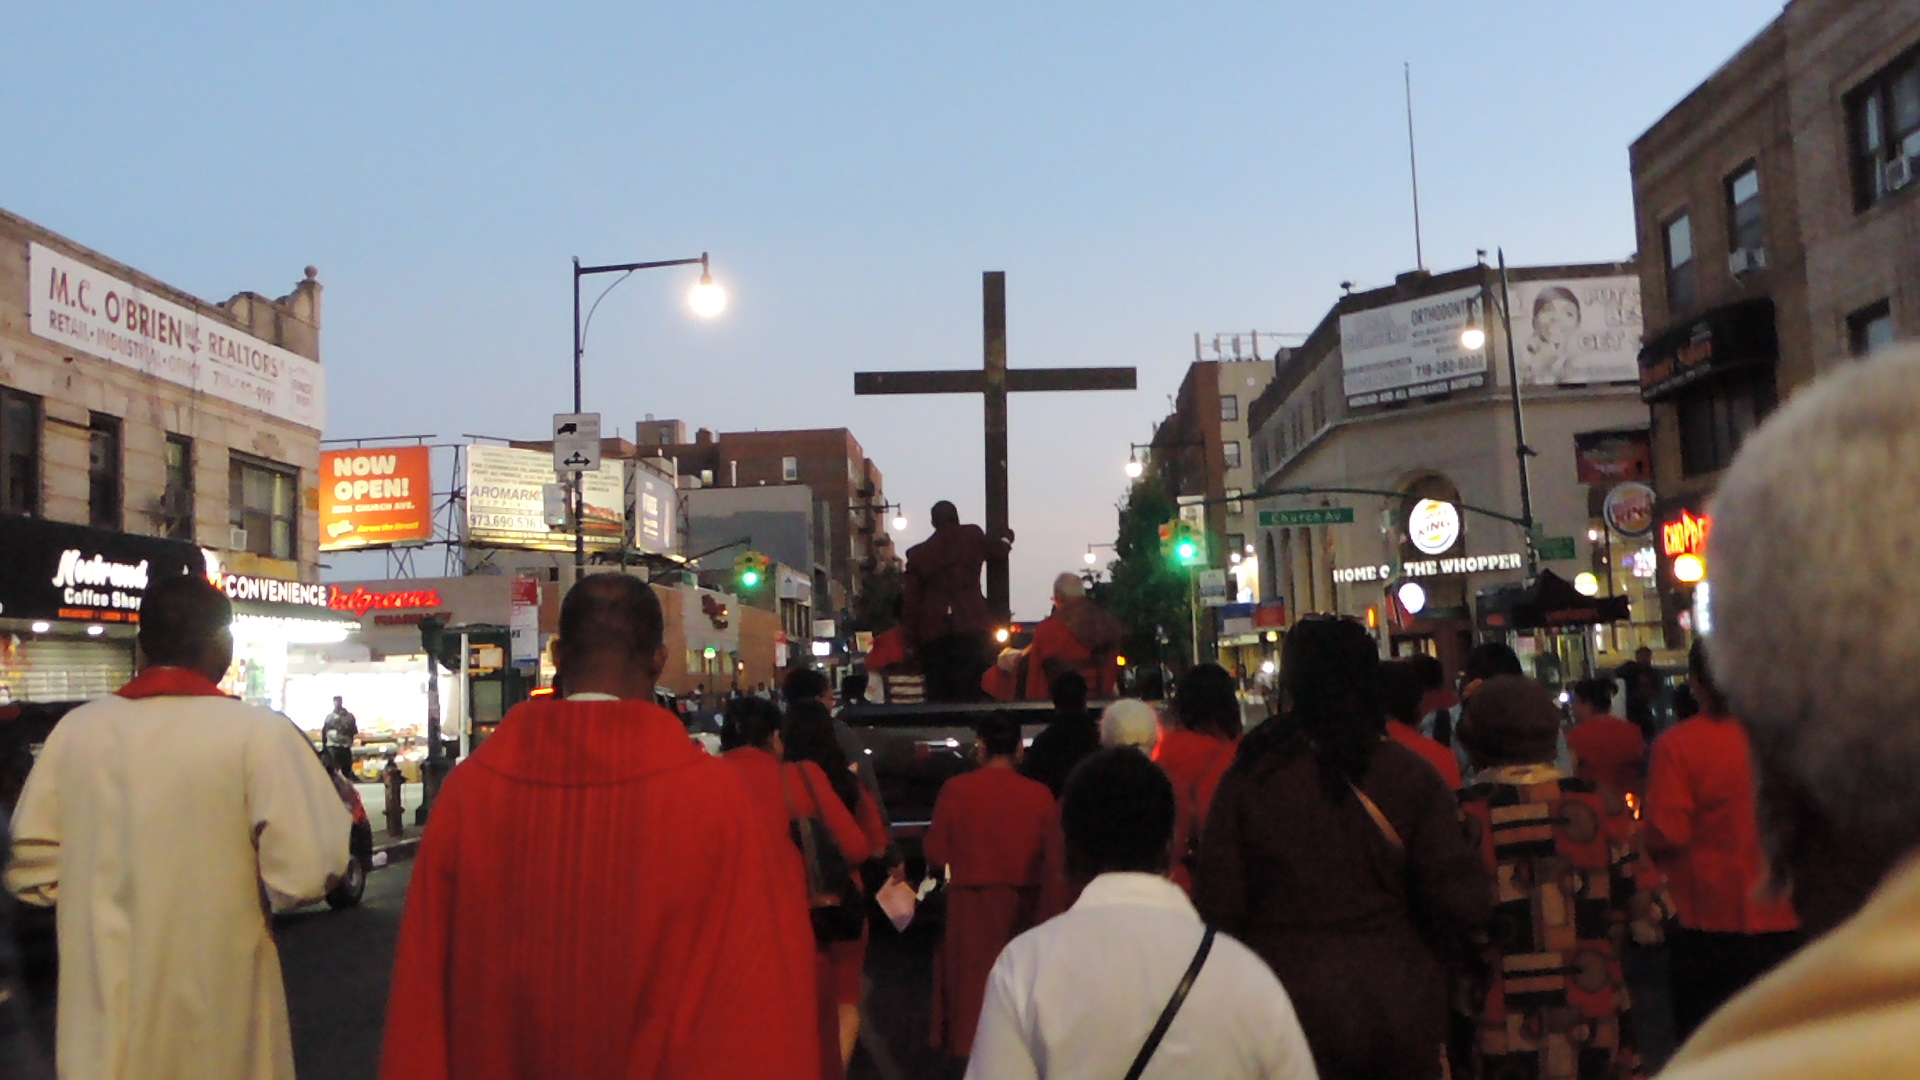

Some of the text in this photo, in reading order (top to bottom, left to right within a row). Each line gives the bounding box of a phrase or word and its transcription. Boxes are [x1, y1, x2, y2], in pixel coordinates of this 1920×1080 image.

[49, 266, 97, 317] M.C.
[105, 290, 182, 349] O'BRIEN
[208, 332, 279, 378] REALTORS
[333, 455, 397, 477] NOW
[334, 478, 410, 501] OPEN!
[1271, 511, 1341, 523] Church Av
[1333, 565, 1377, 583] HOME
[1403, 559, 1438, 578] THE
[1440, 552, 1522, 574] WHOPPER
[64, 587, 109, 608] Coffee
[225, 574, 327, 608] CONVENIENCE
